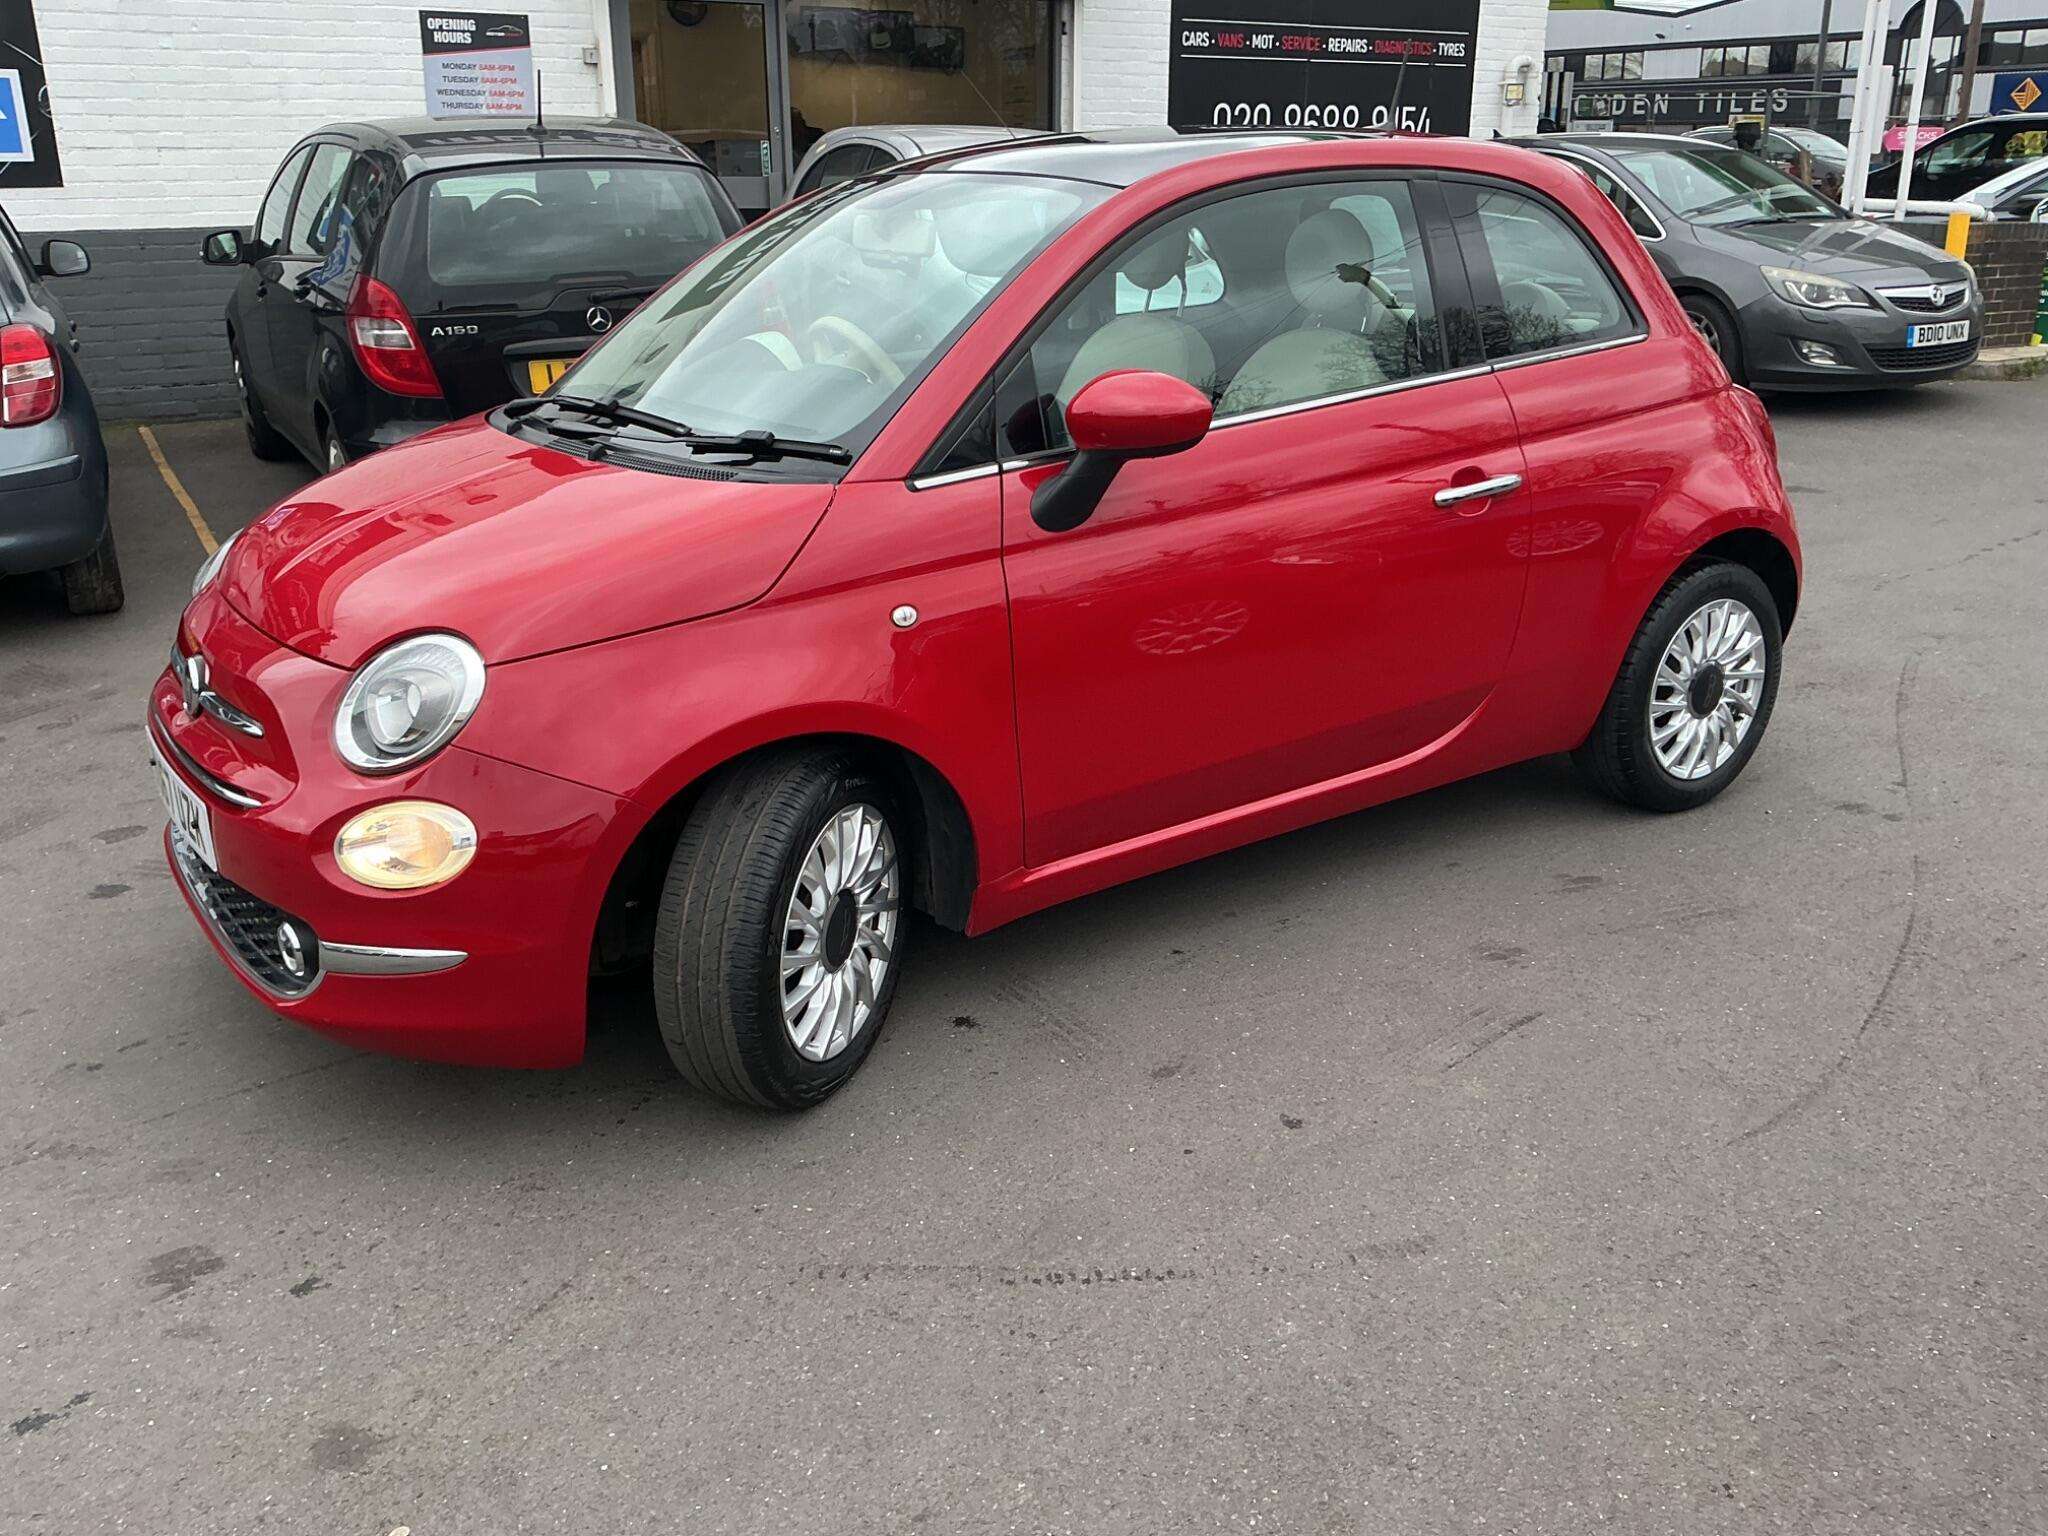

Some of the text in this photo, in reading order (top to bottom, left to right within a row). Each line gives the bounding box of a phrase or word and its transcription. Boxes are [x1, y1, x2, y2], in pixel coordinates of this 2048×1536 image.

[427, 18, 476, 31] OPENING
[433, 31, 472, 44] HOURS
[1181, 30, 1466, 57] CARS VANS MOT SERVICE REPAIRS DIAGNOSTICS TYRES
[442, 63, 477, 71] MONDAY
[442, 75, 479, 84] TUESDAY
[437, 89, 486, 97] WEDNESDAY
[442, 102, 483, 110] THURSDAY
[1696, 88, 1788, 113] TILES
[1897, 131, 1938, 140] SCKS
[1918, 323, 1966, 343] BD10 UNX
